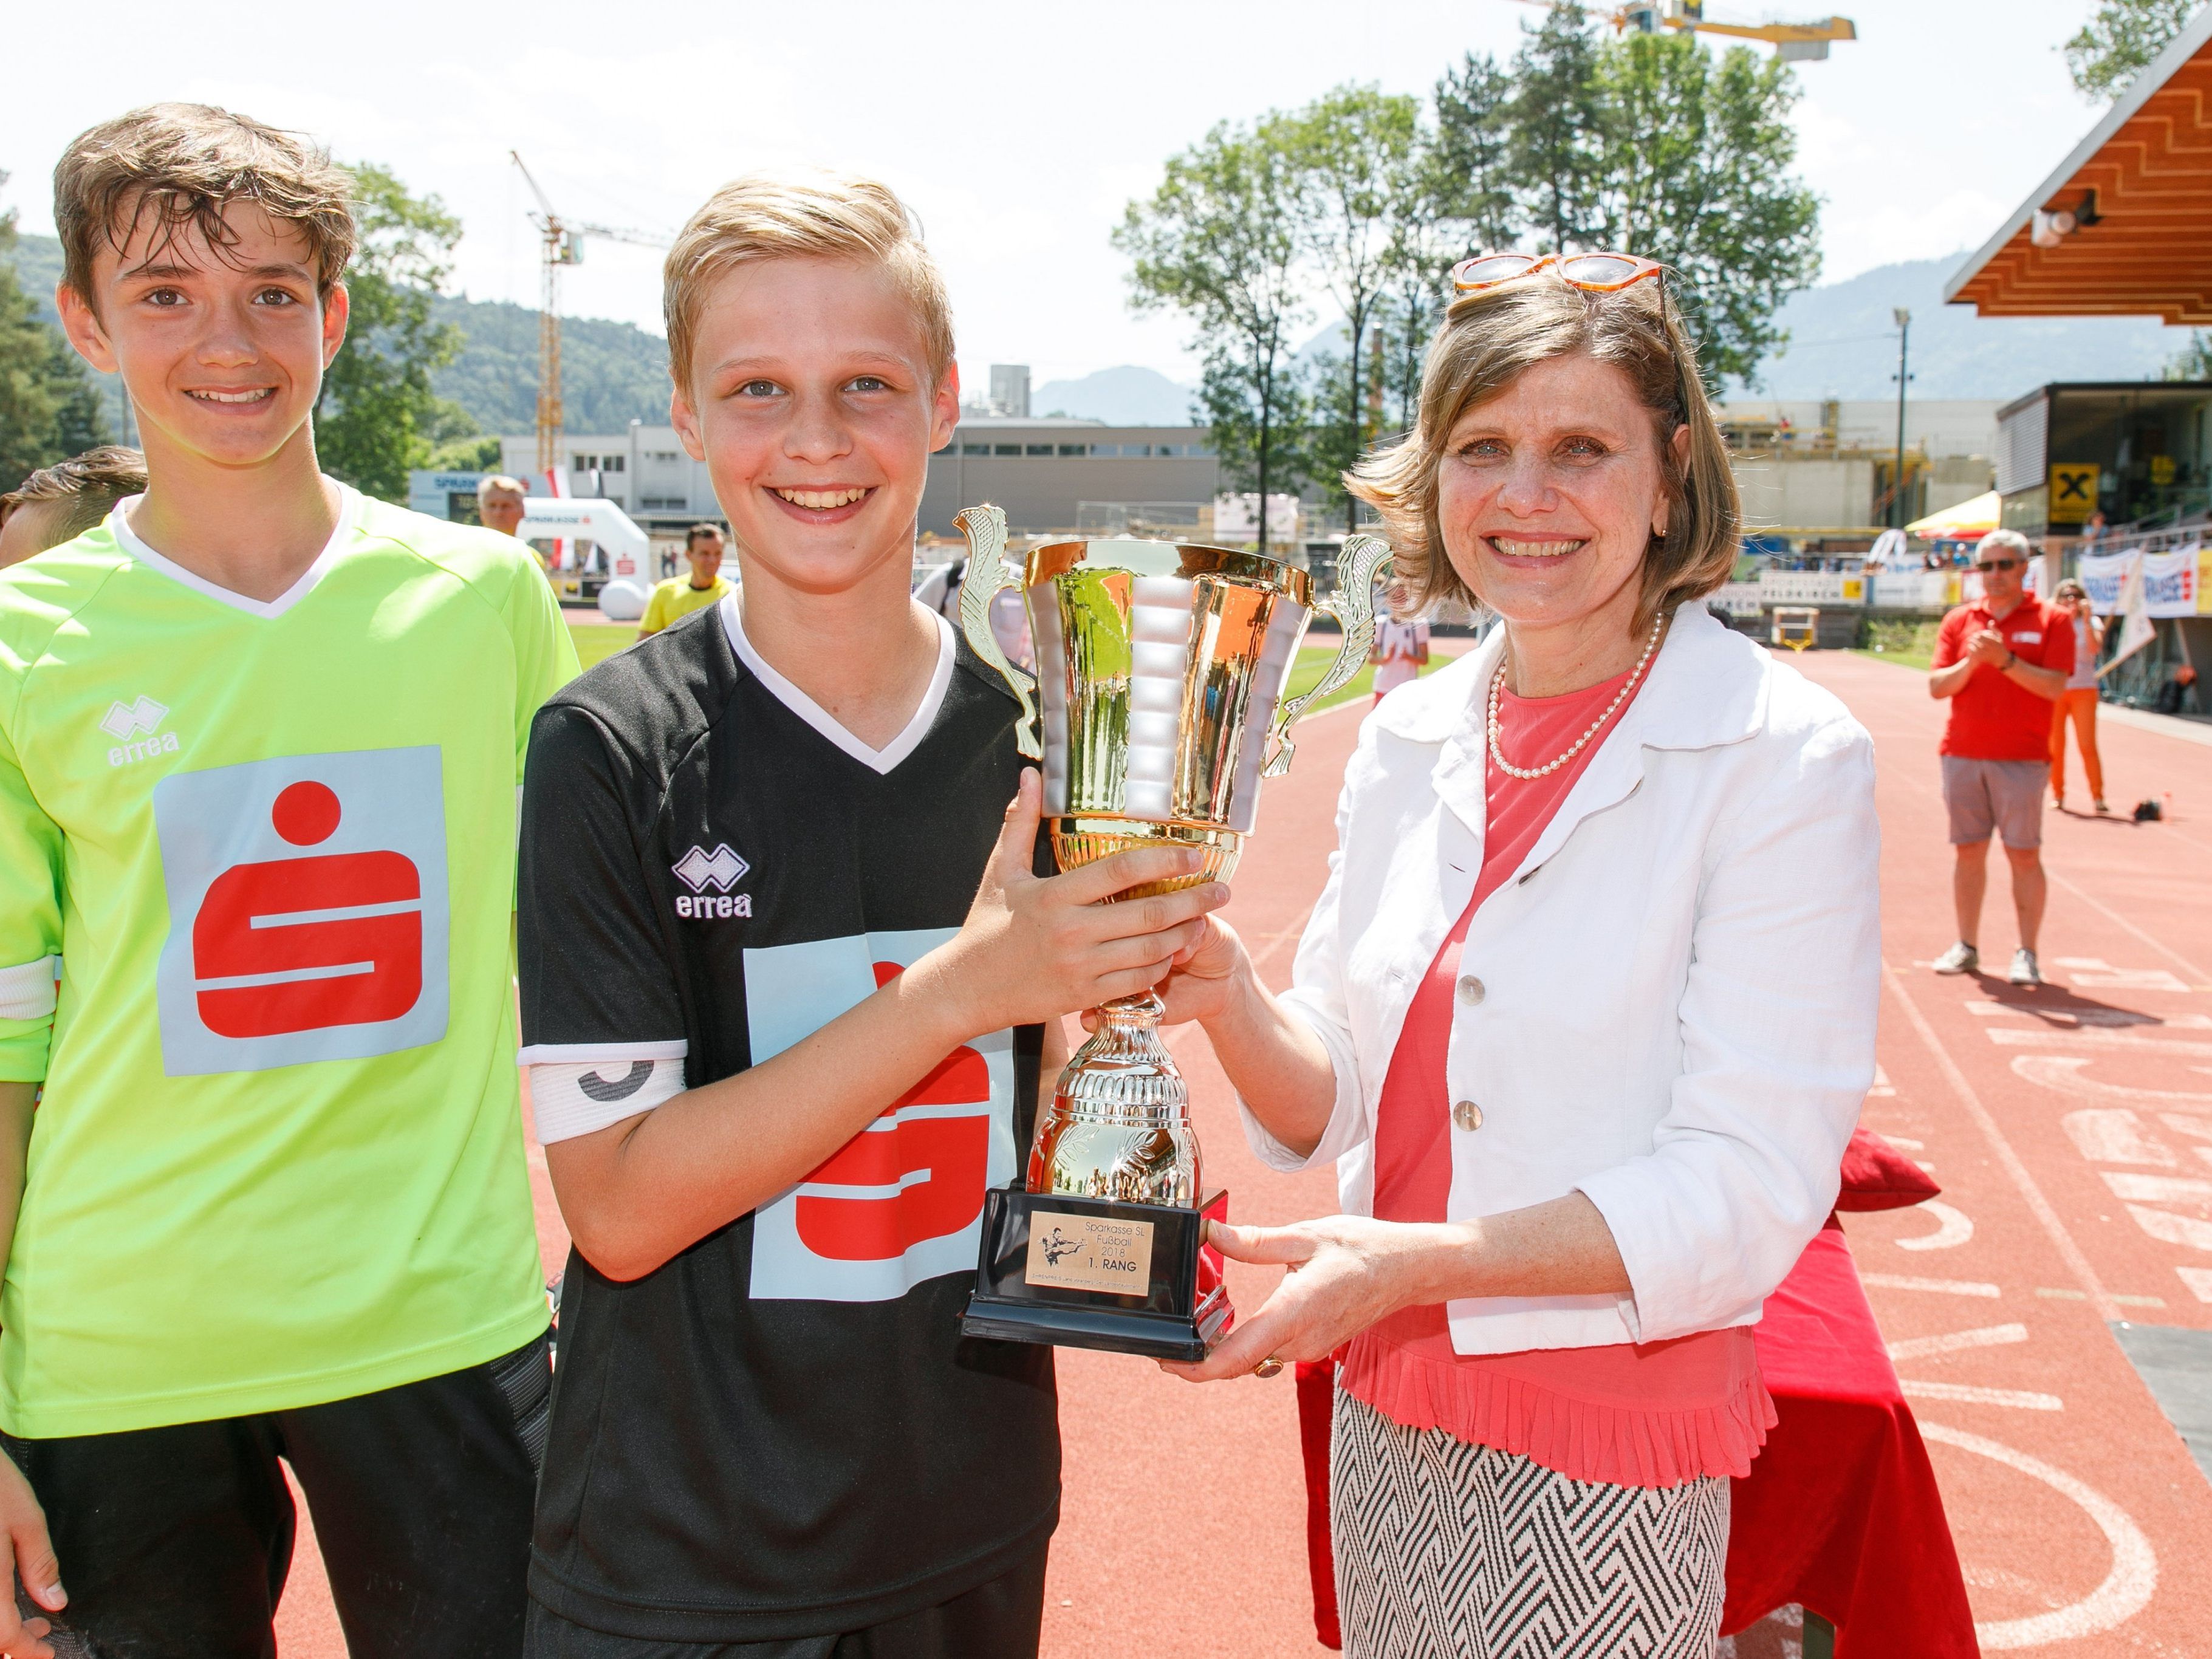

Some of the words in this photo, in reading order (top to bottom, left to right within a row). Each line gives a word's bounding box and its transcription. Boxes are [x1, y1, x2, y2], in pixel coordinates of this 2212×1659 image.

[1762, 589, 1840, 598] FELDKIRCH
[1085, 1222, 1132, 1236] Sparkasse
[1135, 1226, 1145, 1237] SL
[1097, 1234, 1132, 1247] Fußball
[1101, 1246, 1125, 1257] 2018
[1089, 1257, 1098, 1268] 1.
[1103, 1259, 1137, 1272] RANG
